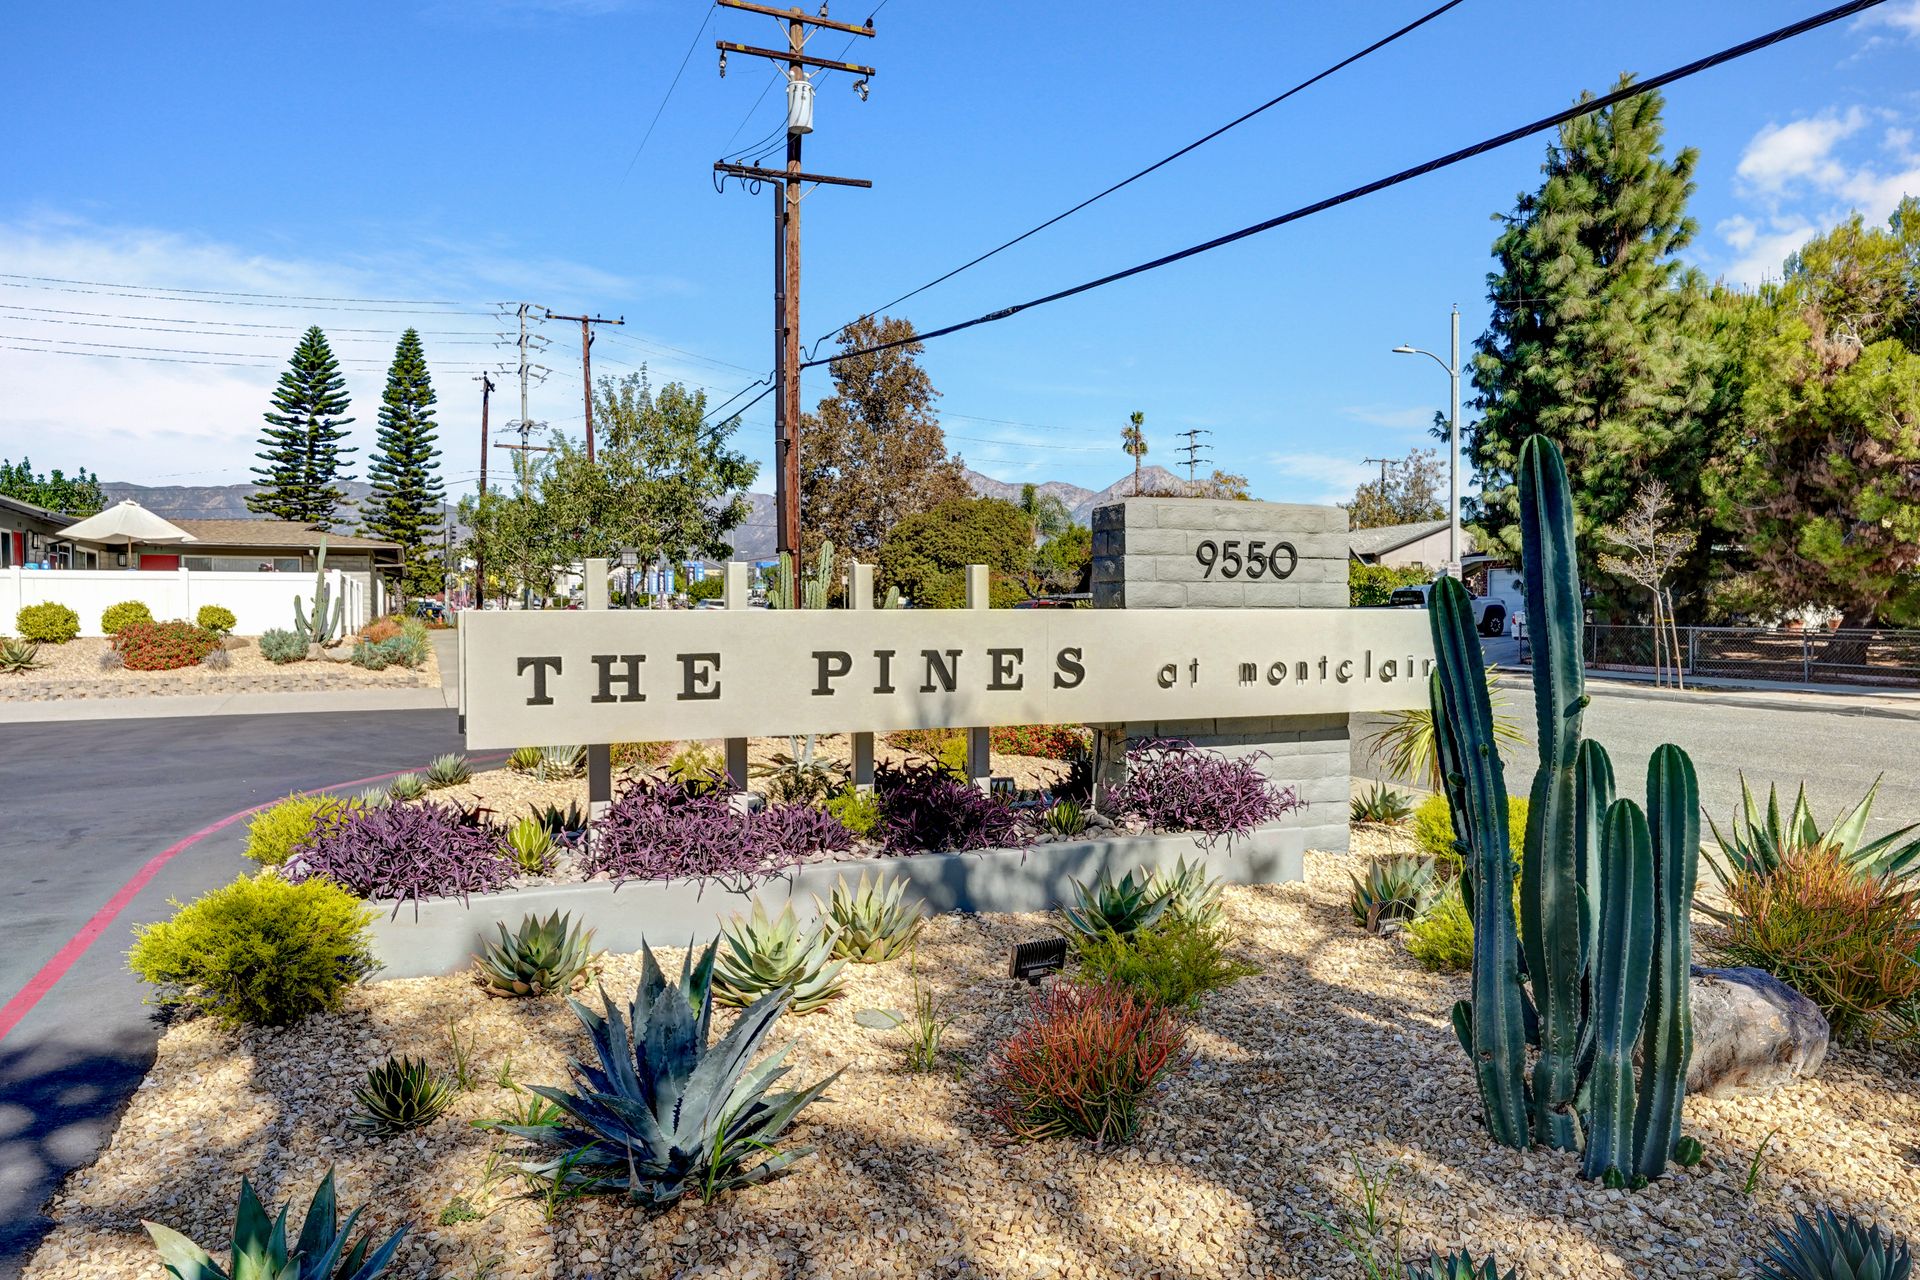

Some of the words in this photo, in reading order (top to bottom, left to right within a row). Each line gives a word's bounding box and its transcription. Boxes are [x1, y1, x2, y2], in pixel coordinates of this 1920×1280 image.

[1196, 539, 1298, 580] 9550
[516, 652, 721, 706] THE
[811, 647, 1086, 696] PINES
[1157, 657, 1200, 688] at
[1238, 650, 1436, 688] montclair
